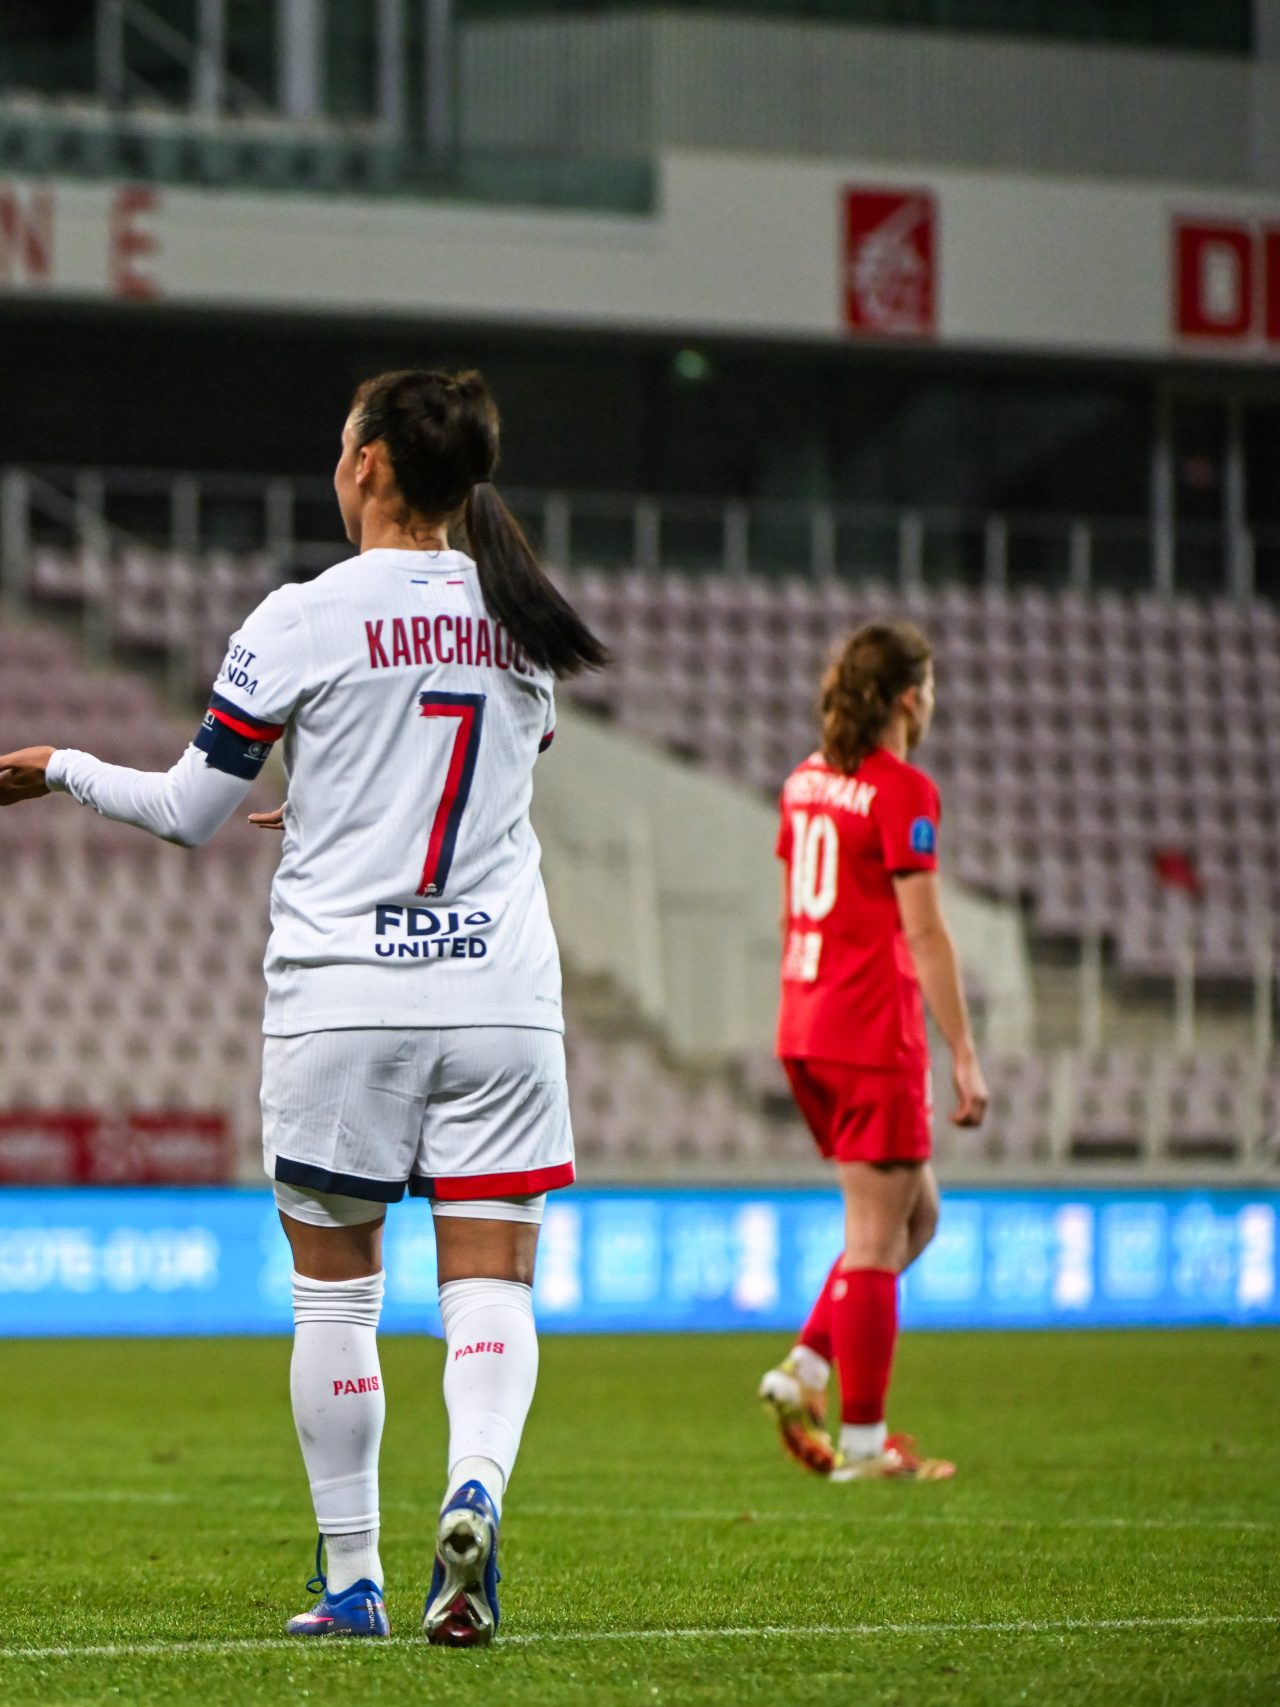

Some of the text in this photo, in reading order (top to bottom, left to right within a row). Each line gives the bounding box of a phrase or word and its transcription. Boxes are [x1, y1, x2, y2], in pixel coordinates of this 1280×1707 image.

[365, 615, 536, 678] KARCHAO
[416, 690, 487, 897] 7
[790, 810, 839, 921] 10
[375, 904, 461, 937] FDJ
[375, 936, 488, 959] UNITED
[454, 1341, 505, 1361] PARIS
[332, 1375, 379, 1396] PARIS
